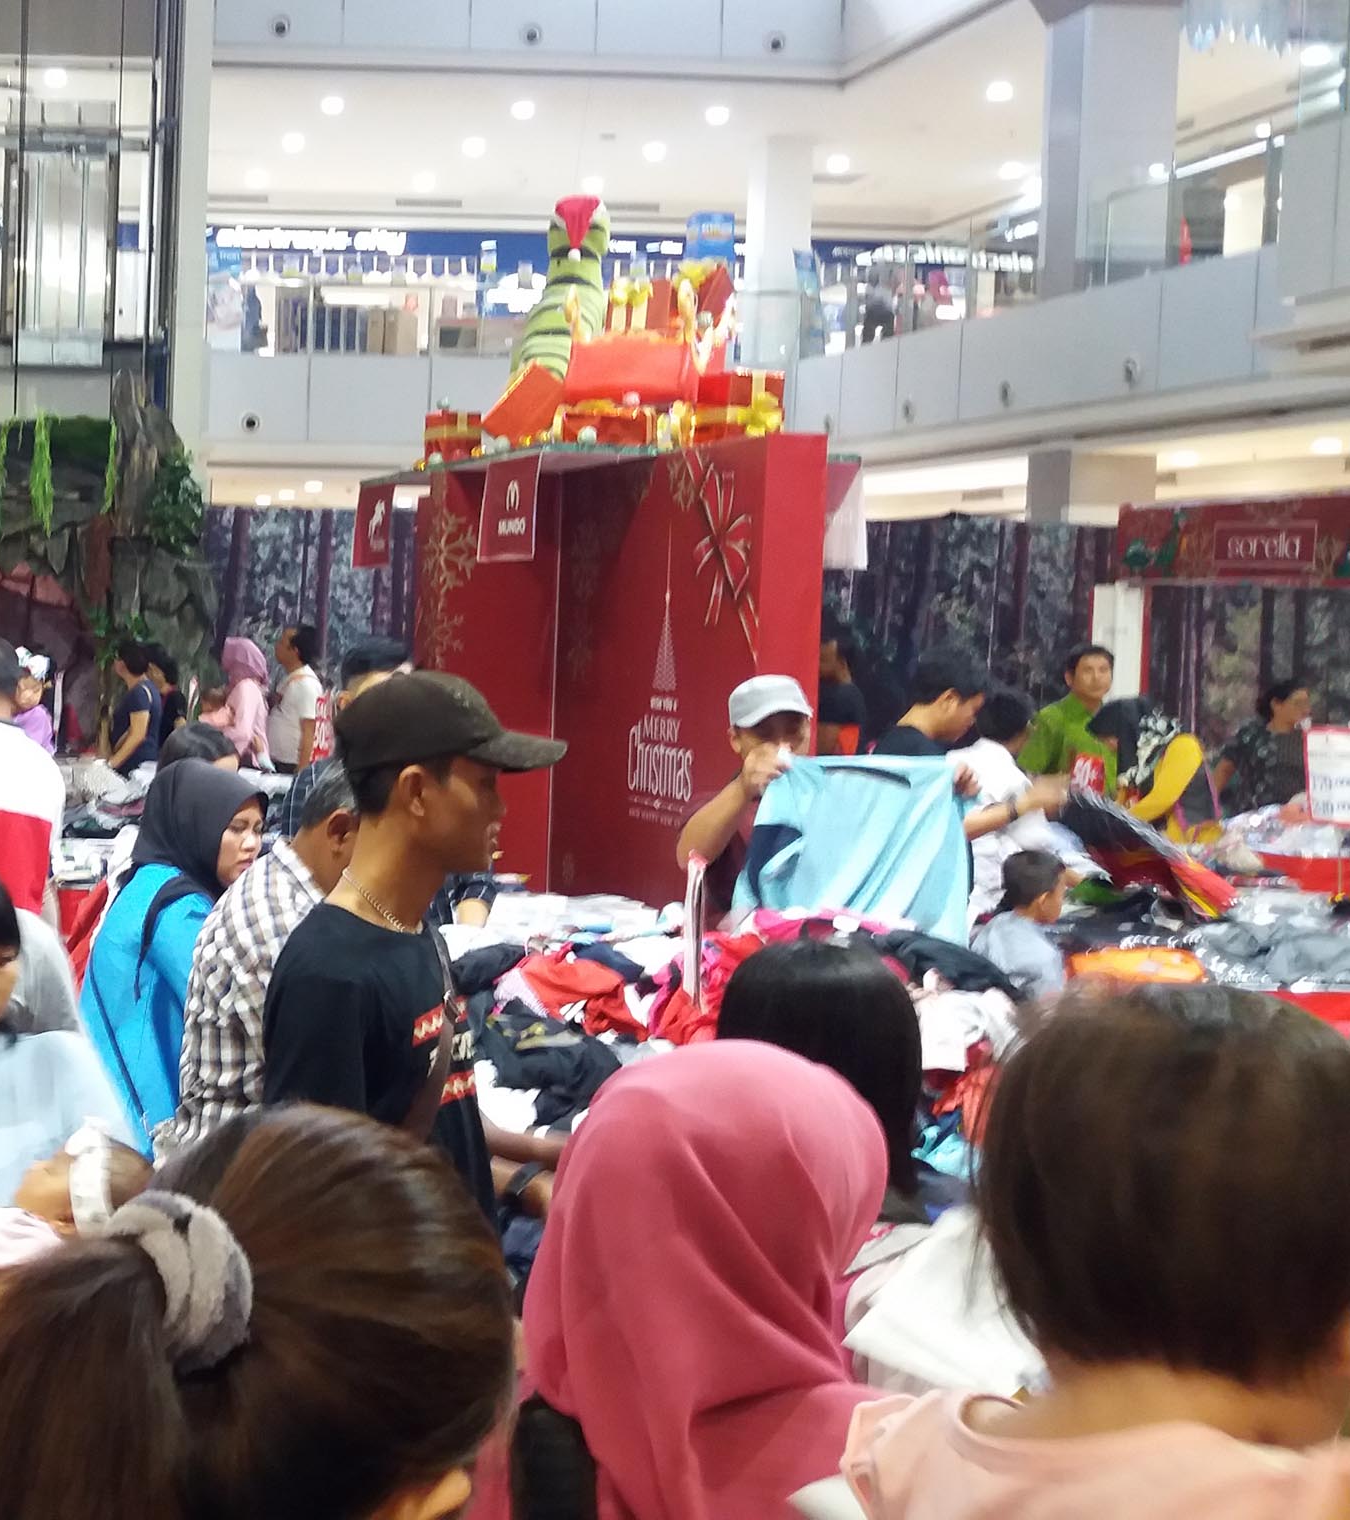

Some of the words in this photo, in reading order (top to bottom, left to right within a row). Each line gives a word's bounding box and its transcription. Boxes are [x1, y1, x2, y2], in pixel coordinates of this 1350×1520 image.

[498, 517, 527, 536] MUNDO
[643, 714, 682, 743] MERRY
[627, 720, 693, 802] Christmas
